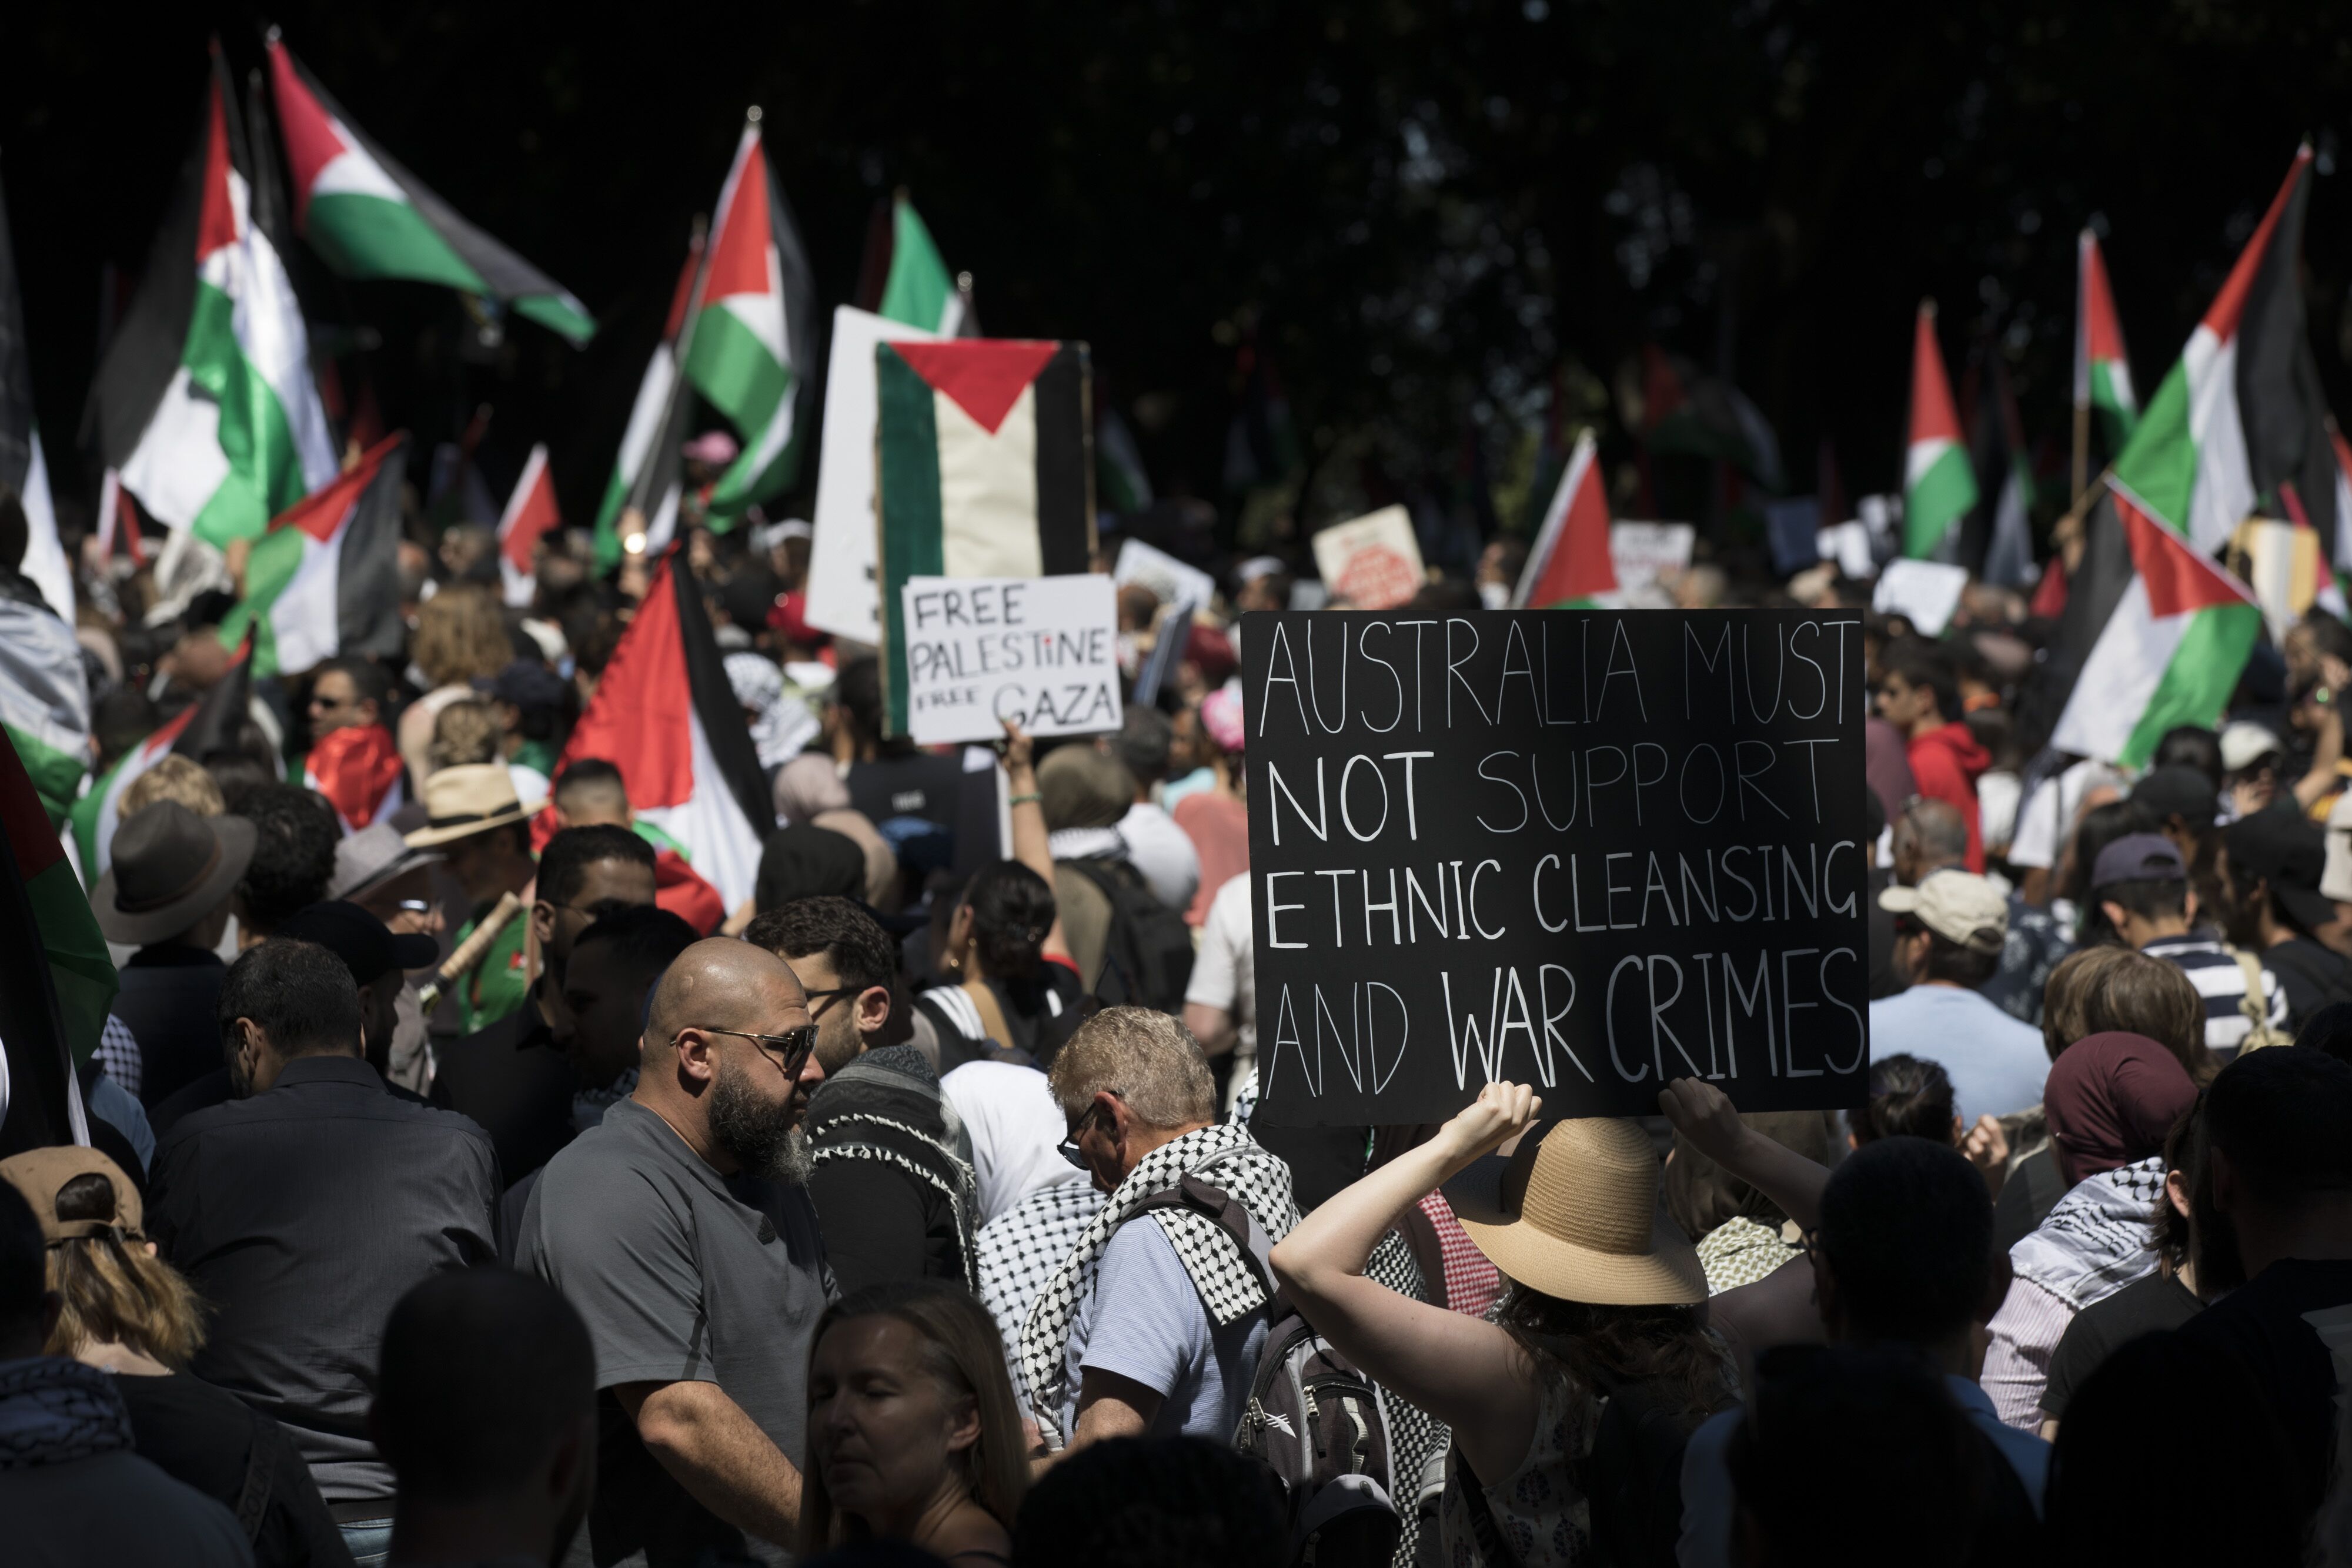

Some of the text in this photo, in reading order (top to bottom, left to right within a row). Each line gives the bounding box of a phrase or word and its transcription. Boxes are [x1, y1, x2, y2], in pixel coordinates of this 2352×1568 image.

[914, 583, 1026, 630] FREE
[916, 681, 1115, 728] FREE GAZA
[1259, 618, 1861, 737] AUSTRALIA MUST
[1268, 738, 1839, 847] NOT SUPPORT
[1266, 841, 1858, 949] ETHNIC CLEANSING
[1265, 948, 1866, 1099] AND WAR CRIMES
